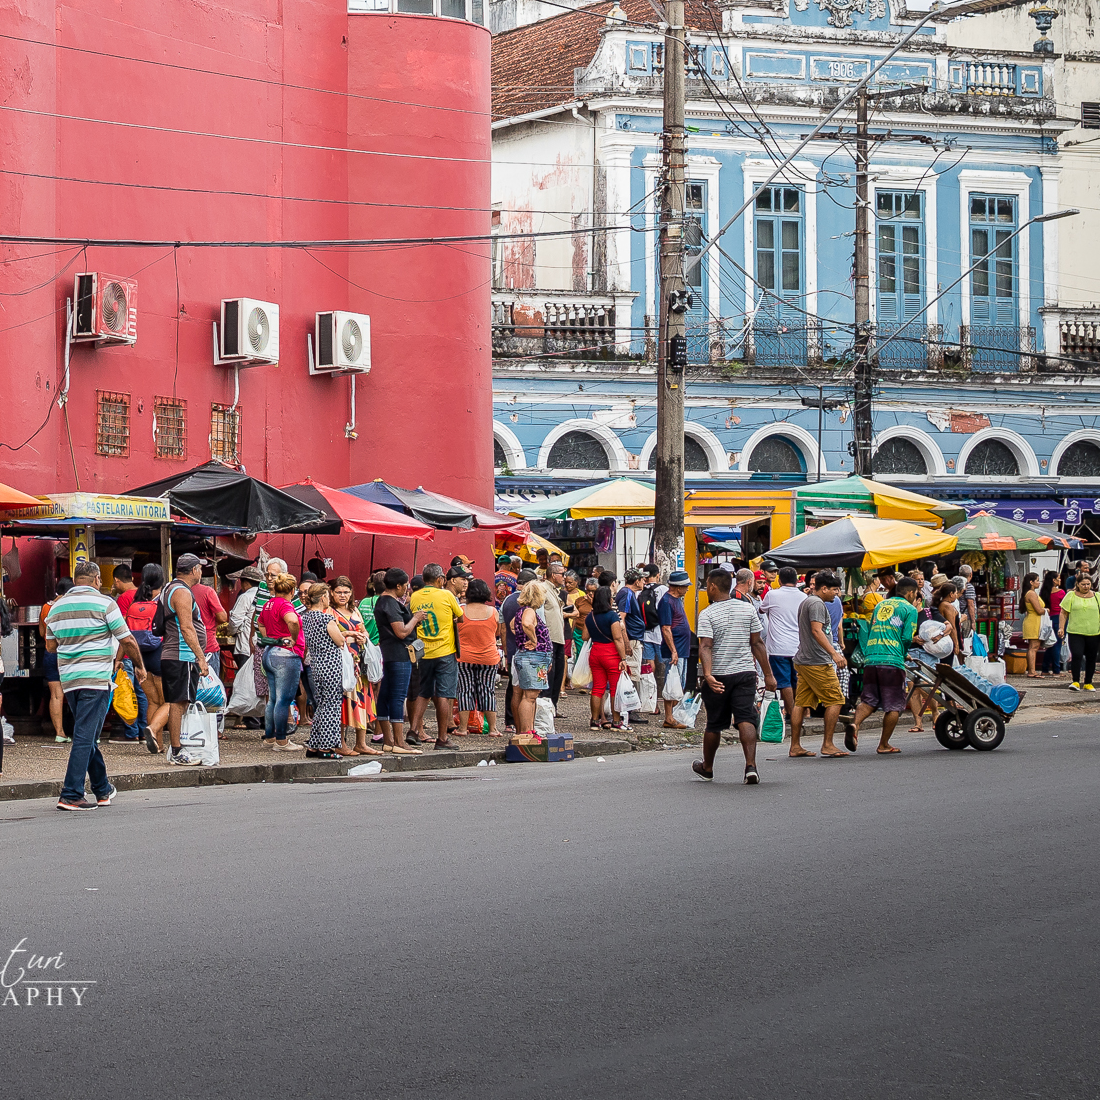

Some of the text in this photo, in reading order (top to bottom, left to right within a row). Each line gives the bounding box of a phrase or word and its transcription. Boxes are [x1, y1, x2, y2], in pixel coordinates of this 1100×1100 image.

[828, 62, 854, 78] 1906
[86, 501, 168, 519] PASTELARIA VITÓRIA
[421, 610, 440, 637] 10
